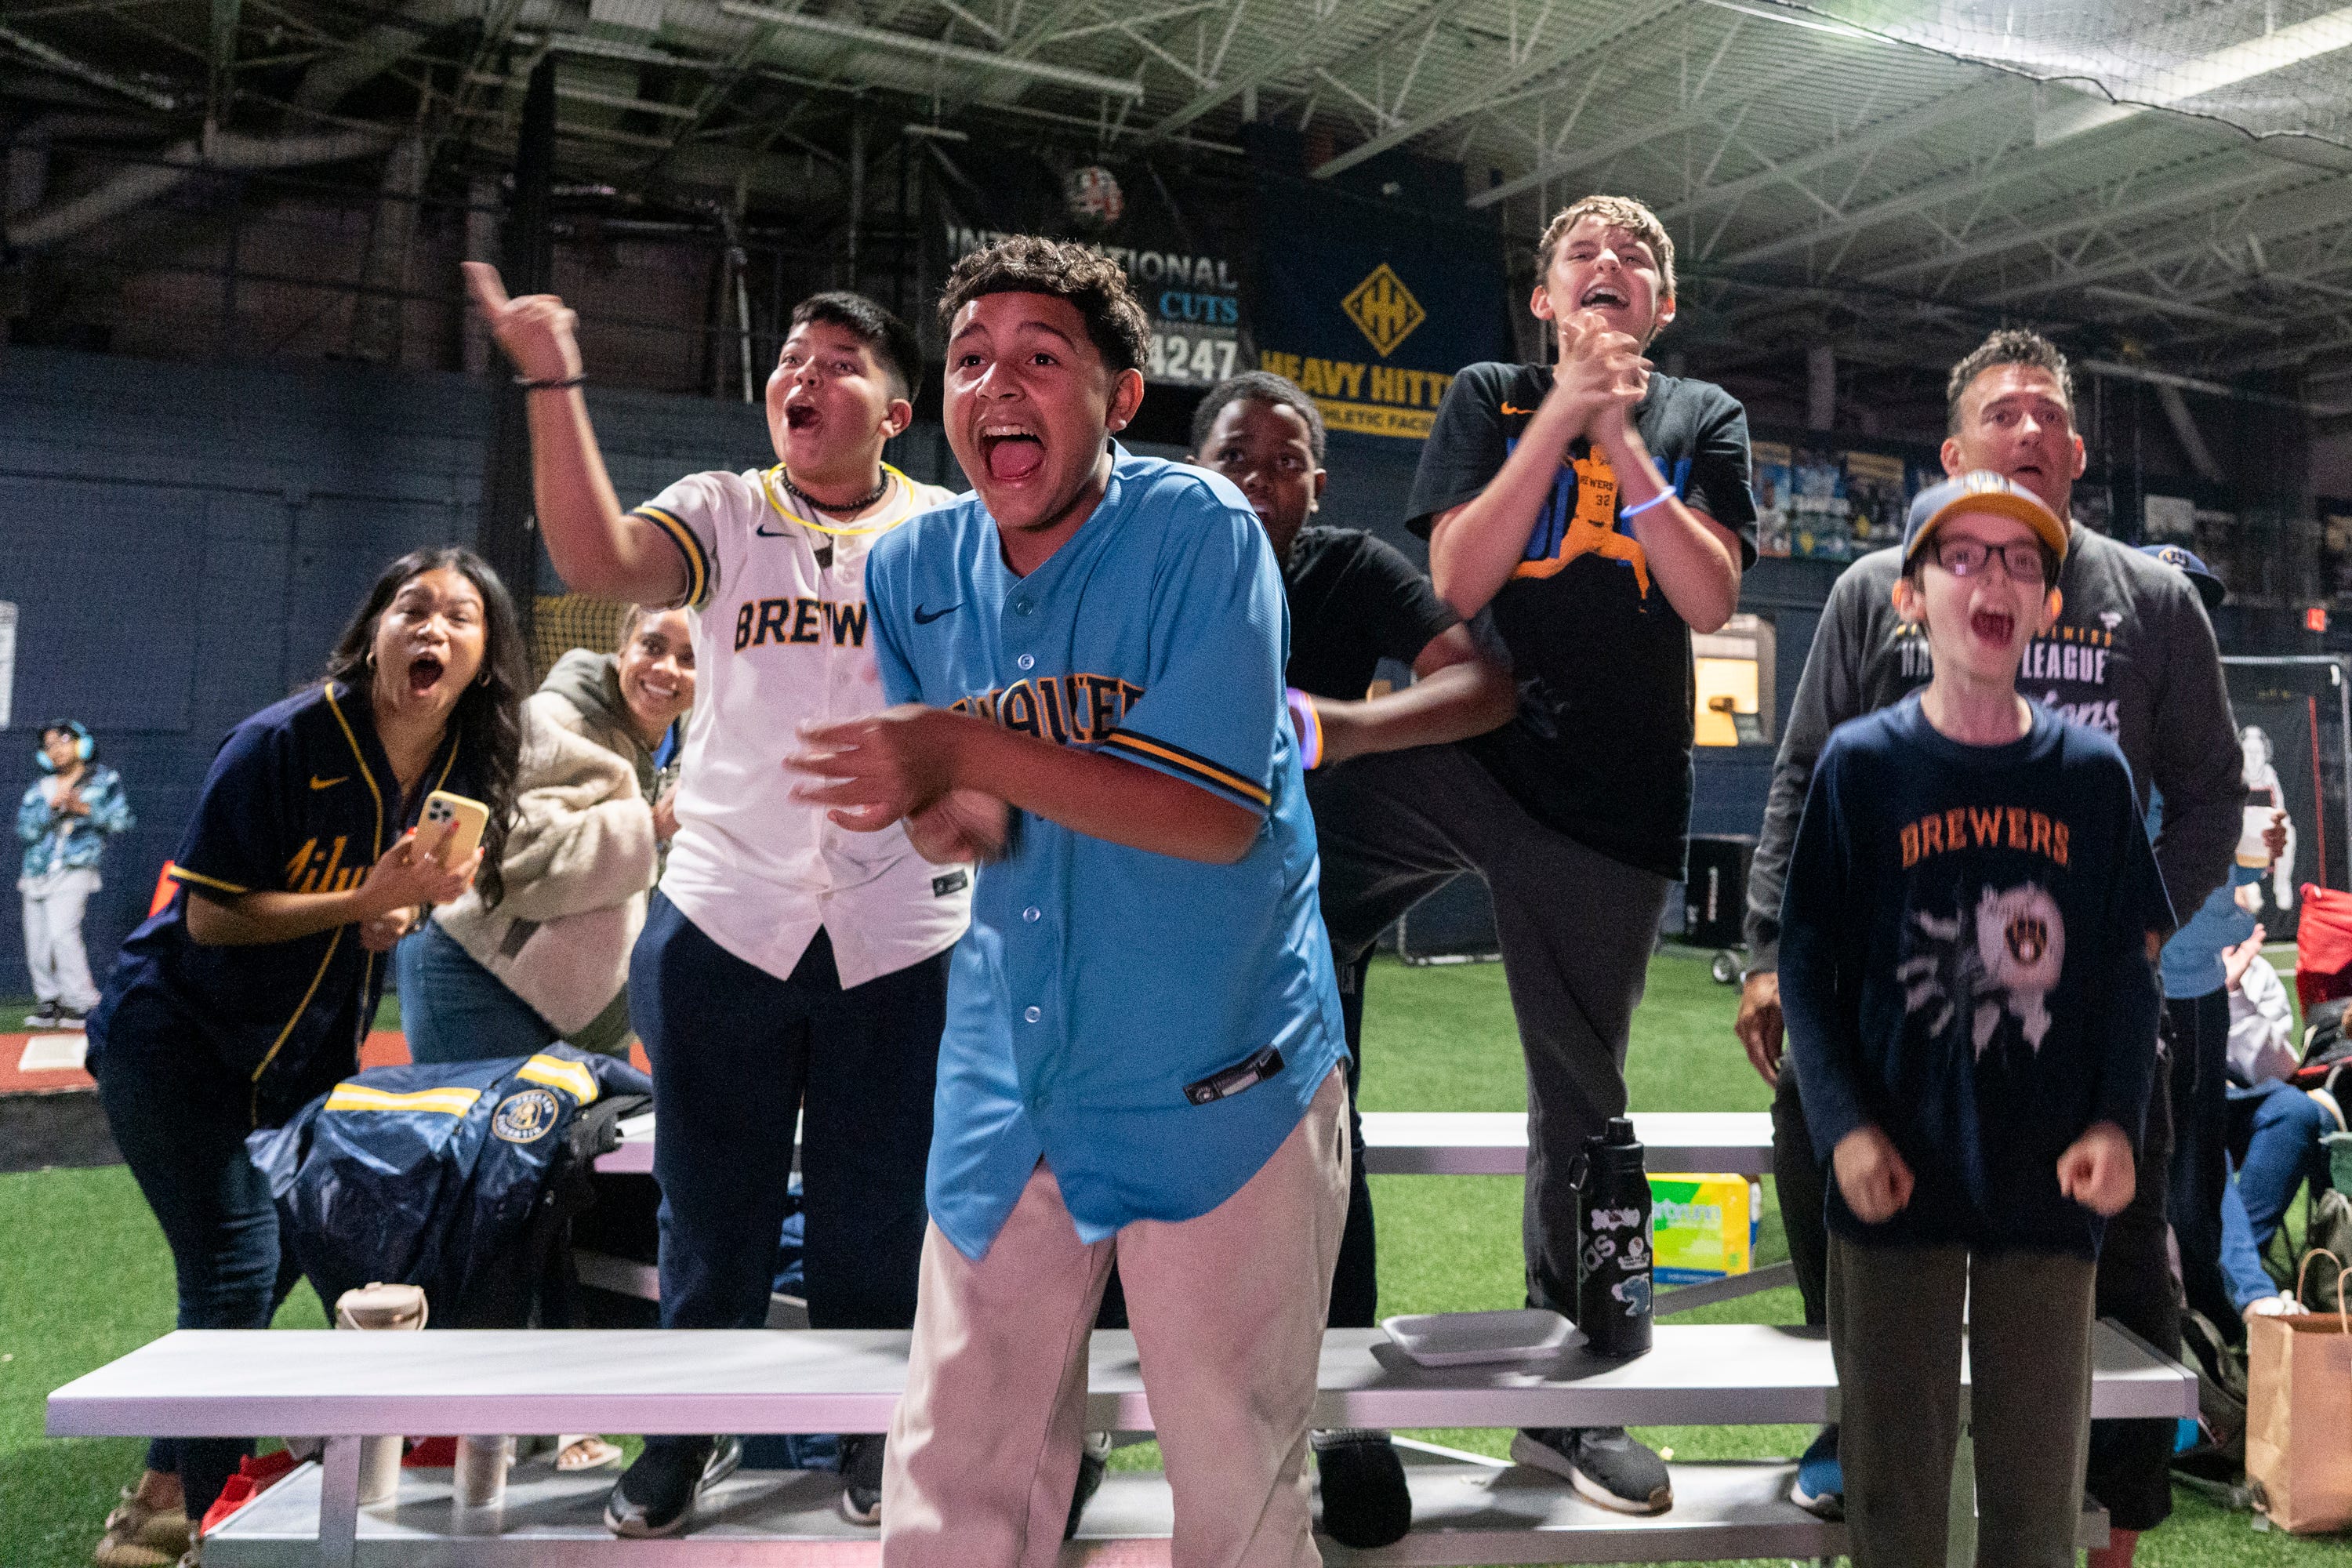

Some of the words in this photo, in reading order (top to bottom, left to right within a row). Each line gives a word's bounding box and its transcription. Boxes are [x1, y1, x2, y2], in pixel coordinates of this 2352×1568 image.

[1160, 291, 1240, 324] CUTS
[1260, 350, 1366, 399] HEAVY
[1370, 365, 1454, 408] HITT
[1595, 494, 1610, 506] 32
[735, 597, 868, 654] BREW
[2021, 642, 2107, 684] LEAGUE
[1900, 805, 2070, 869] BREWERS
